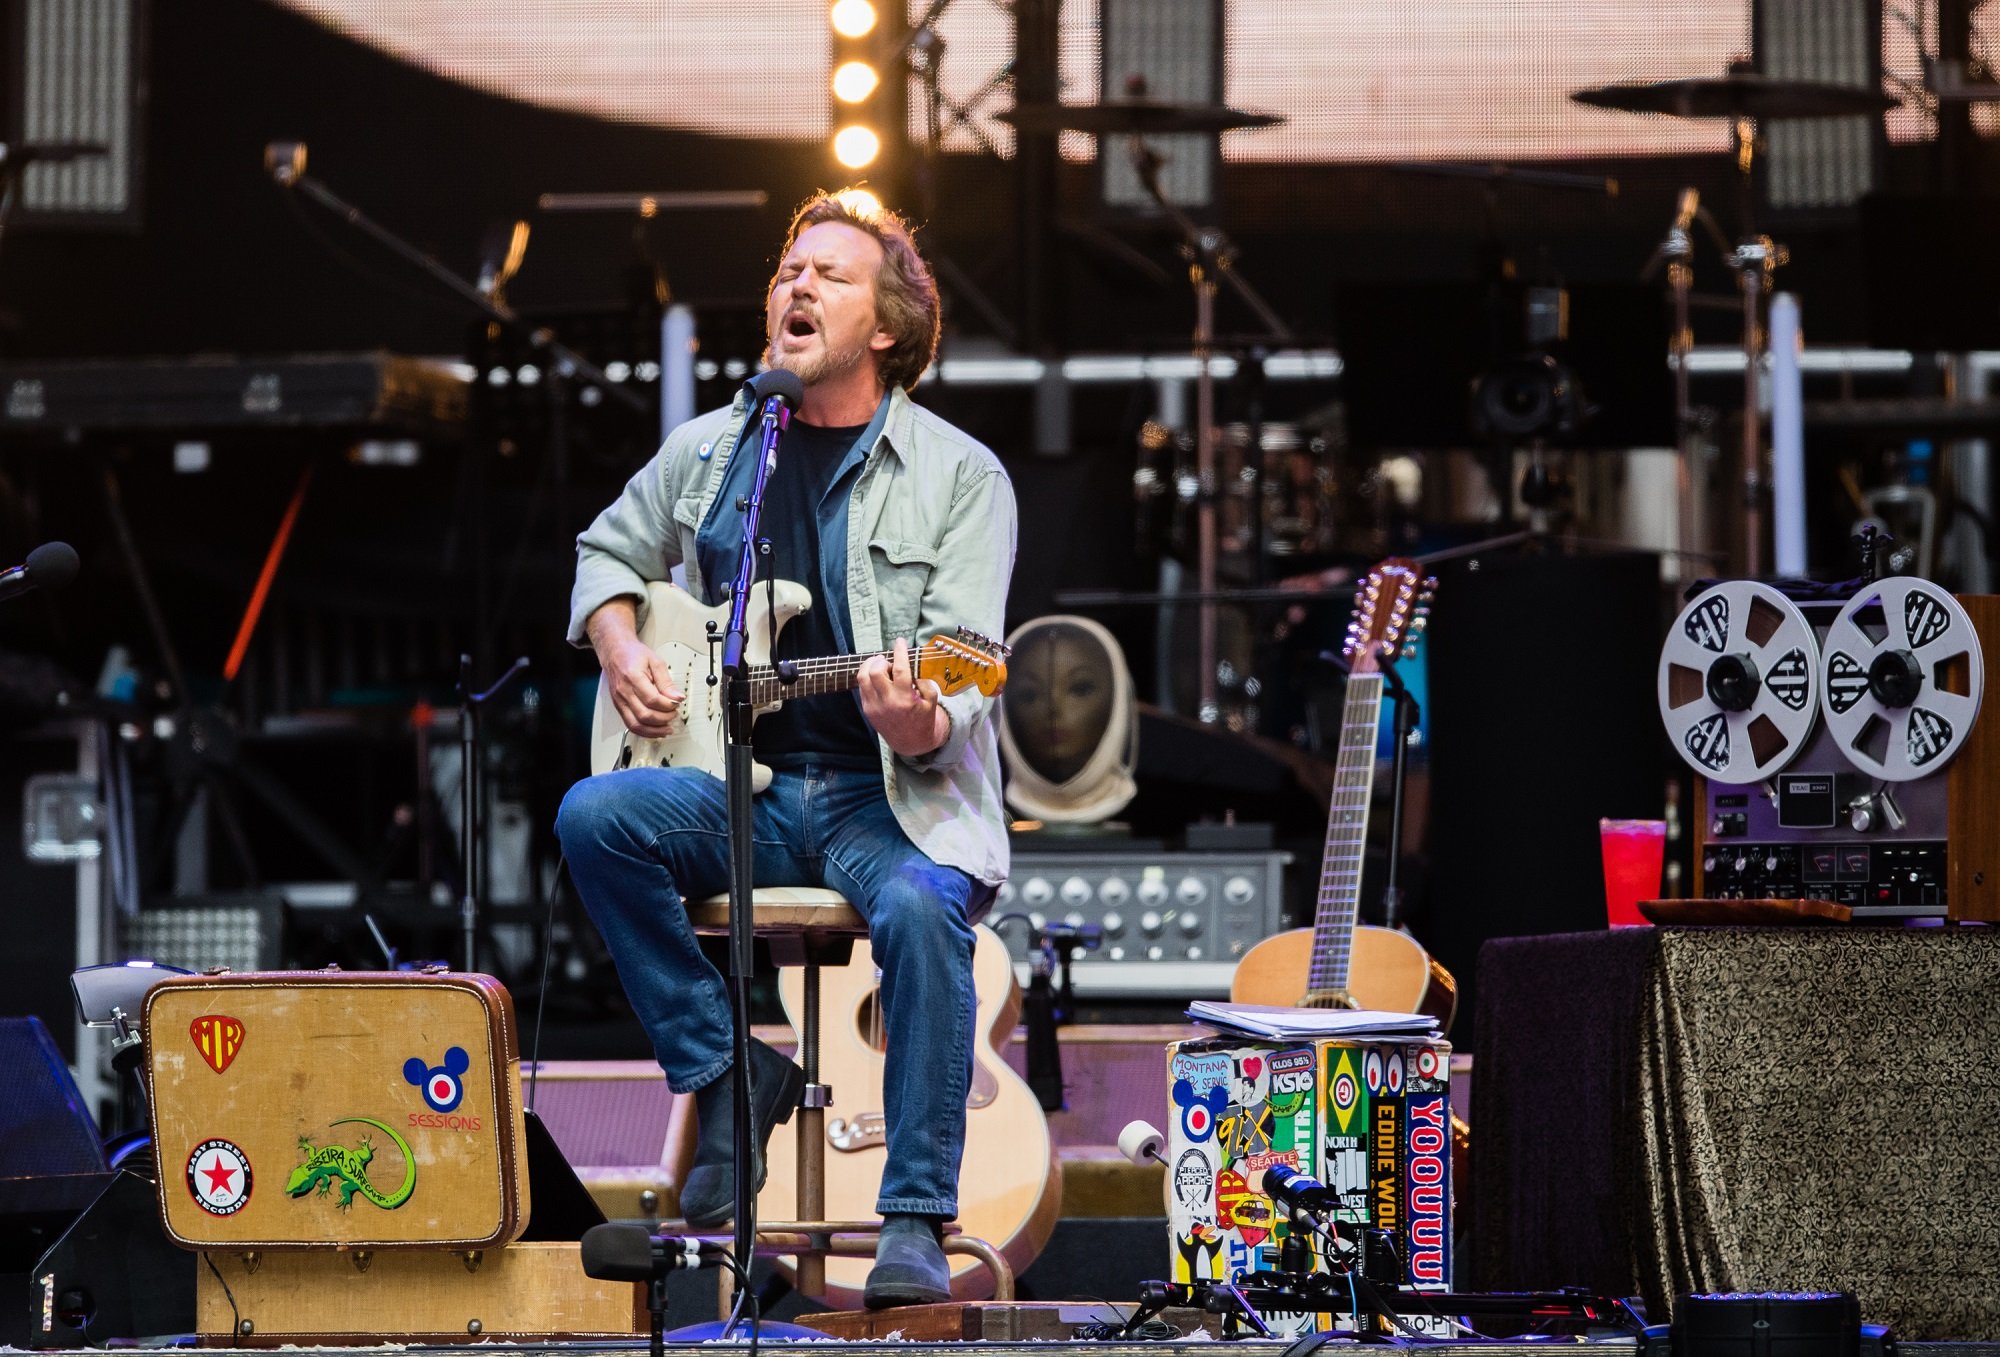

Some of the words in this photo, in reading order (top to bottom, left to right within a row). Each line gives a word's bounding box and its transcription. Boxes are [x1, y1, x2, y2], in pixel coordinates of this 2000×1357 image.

[1175, 1057, 1228, 1074] MONTANA
[1272, 1059, 1293, 1070] KLOS
[408, 1113, 481, 1130] SESSIONS
[1325, 1136, 1358, 1149] NORTH
[1377, 1105, 1396, 1173] EDDIE
[188, 1144, 206, 1174] EASY
[208, 1141, 250, 1172] STREET
[1250, 1152, 1295, 1169] SEATTLE
[1179, 1166, 1209, 1175] PIERCED
[1175, 1175, 1213, 1186] ARROWS
[195, 1193, 247, 1215] RECORDS
[1339, 1194, 1367, 1208] WEST
[1377, 1177, 1396, 1230] WOU
